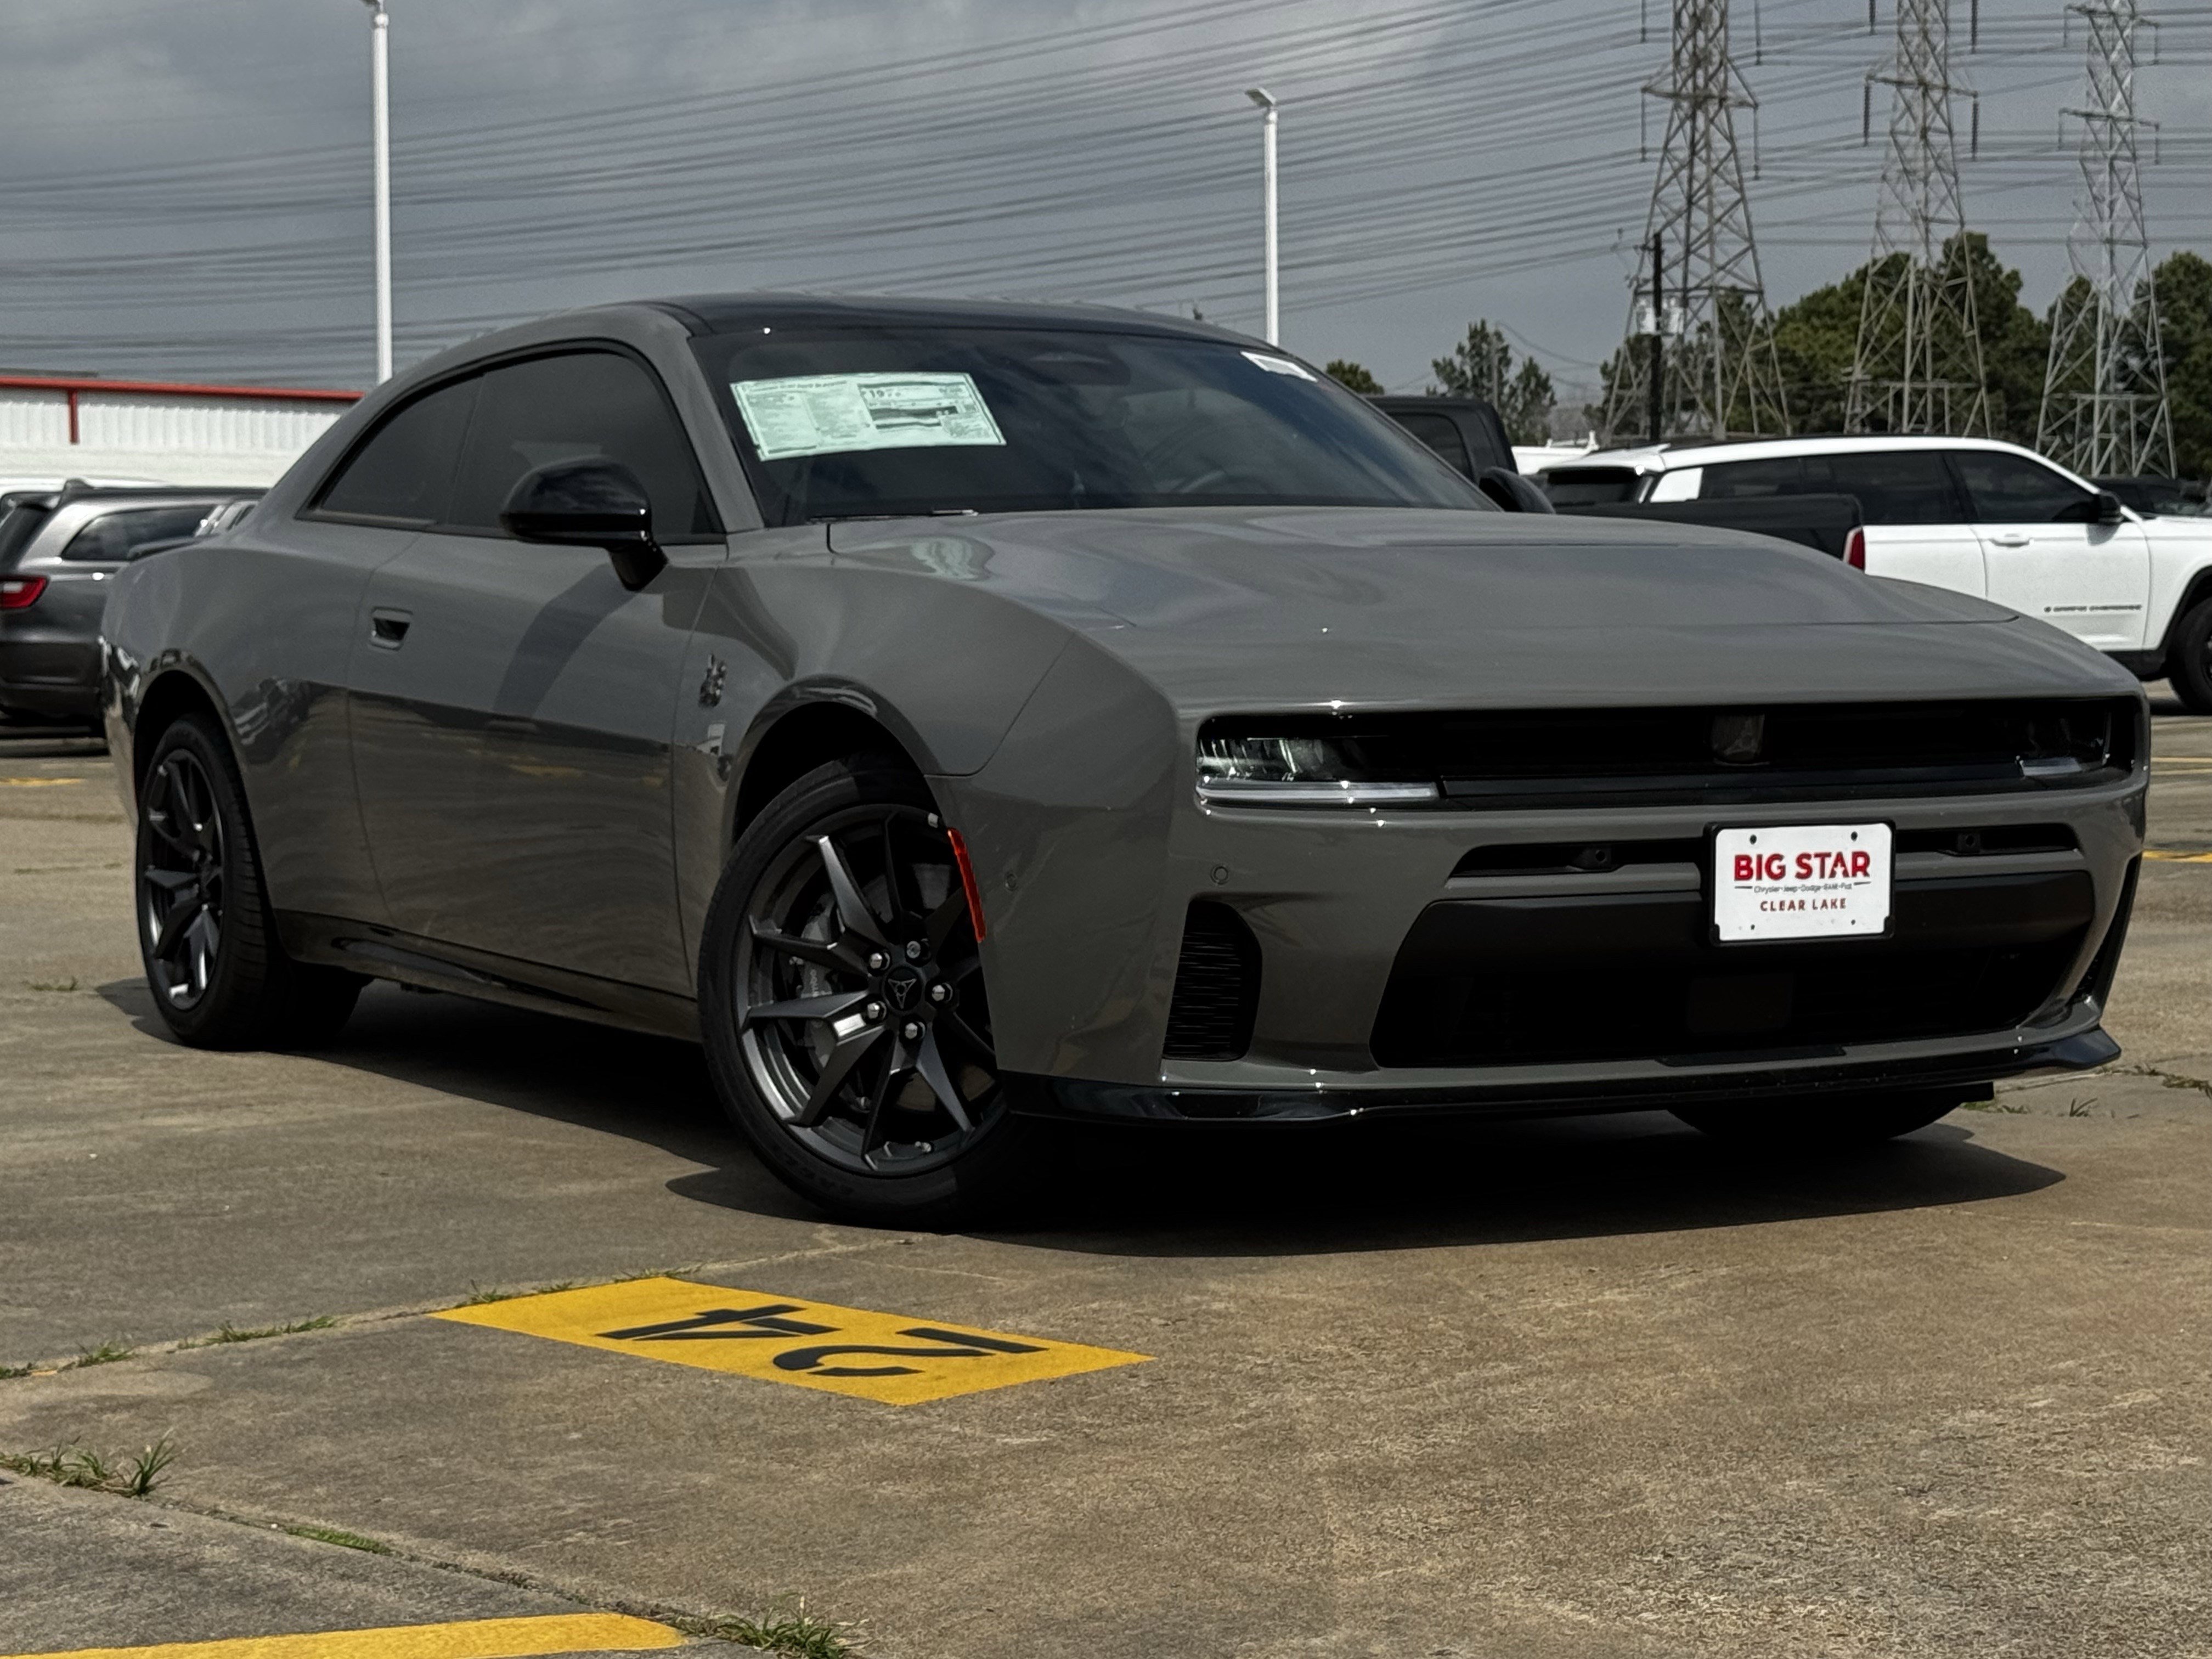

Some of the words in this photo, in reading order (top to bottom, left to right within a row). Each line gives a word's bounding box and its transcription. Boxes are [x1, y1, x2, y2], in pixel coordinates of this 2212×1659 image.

[1734, 854, 1786, 881] BIG
[1795, 851, 1870, 879] STAR
[1760, 900, 1805, 911] CLEAR
[1812, 898, 1846, 910] LAKE
[596, 1305, 1048, 1376] 24
